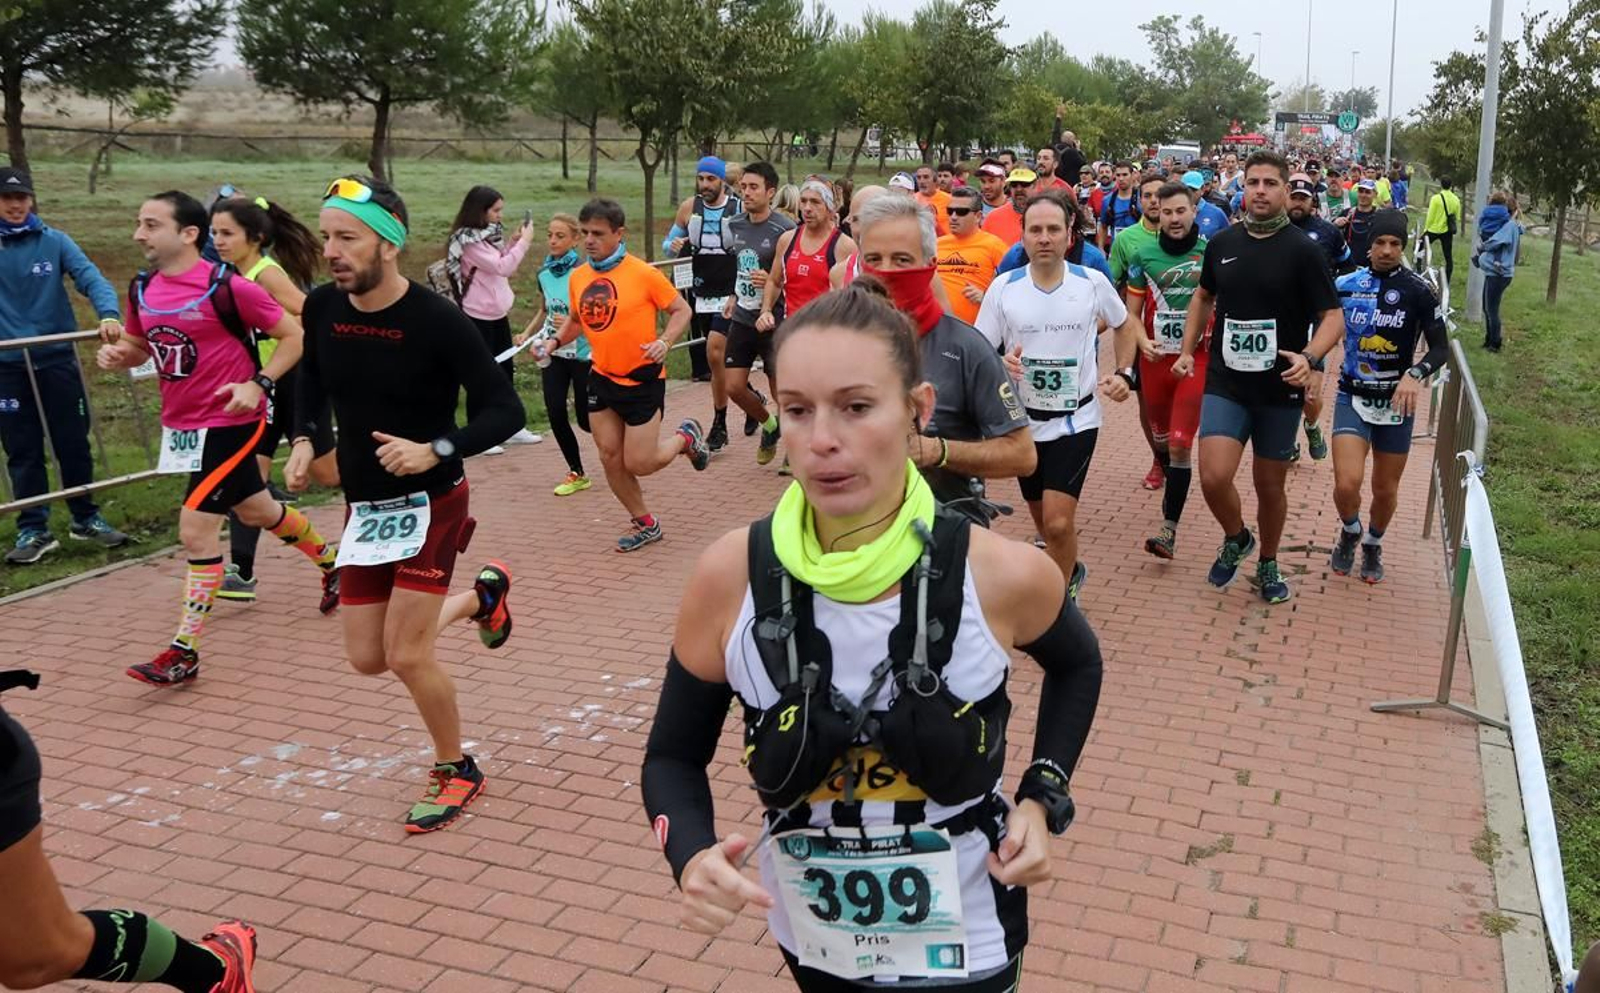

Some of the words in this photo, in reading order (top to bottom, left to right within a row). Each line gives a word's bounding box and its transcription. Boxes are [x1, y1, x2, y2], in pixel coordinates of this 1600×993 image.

[332, 322, 404, 339] WONG
[1229, 333, 1268, 353] 540
[1032, 370, 1062, 391] 53
[169, 430, 199, 452] 300
[354, 513, 418, 543] 269
[871, 837, 902, 850] PIRAT
[803, 866, 932, 927] 399
[854, 932, 891, 947] Pris
